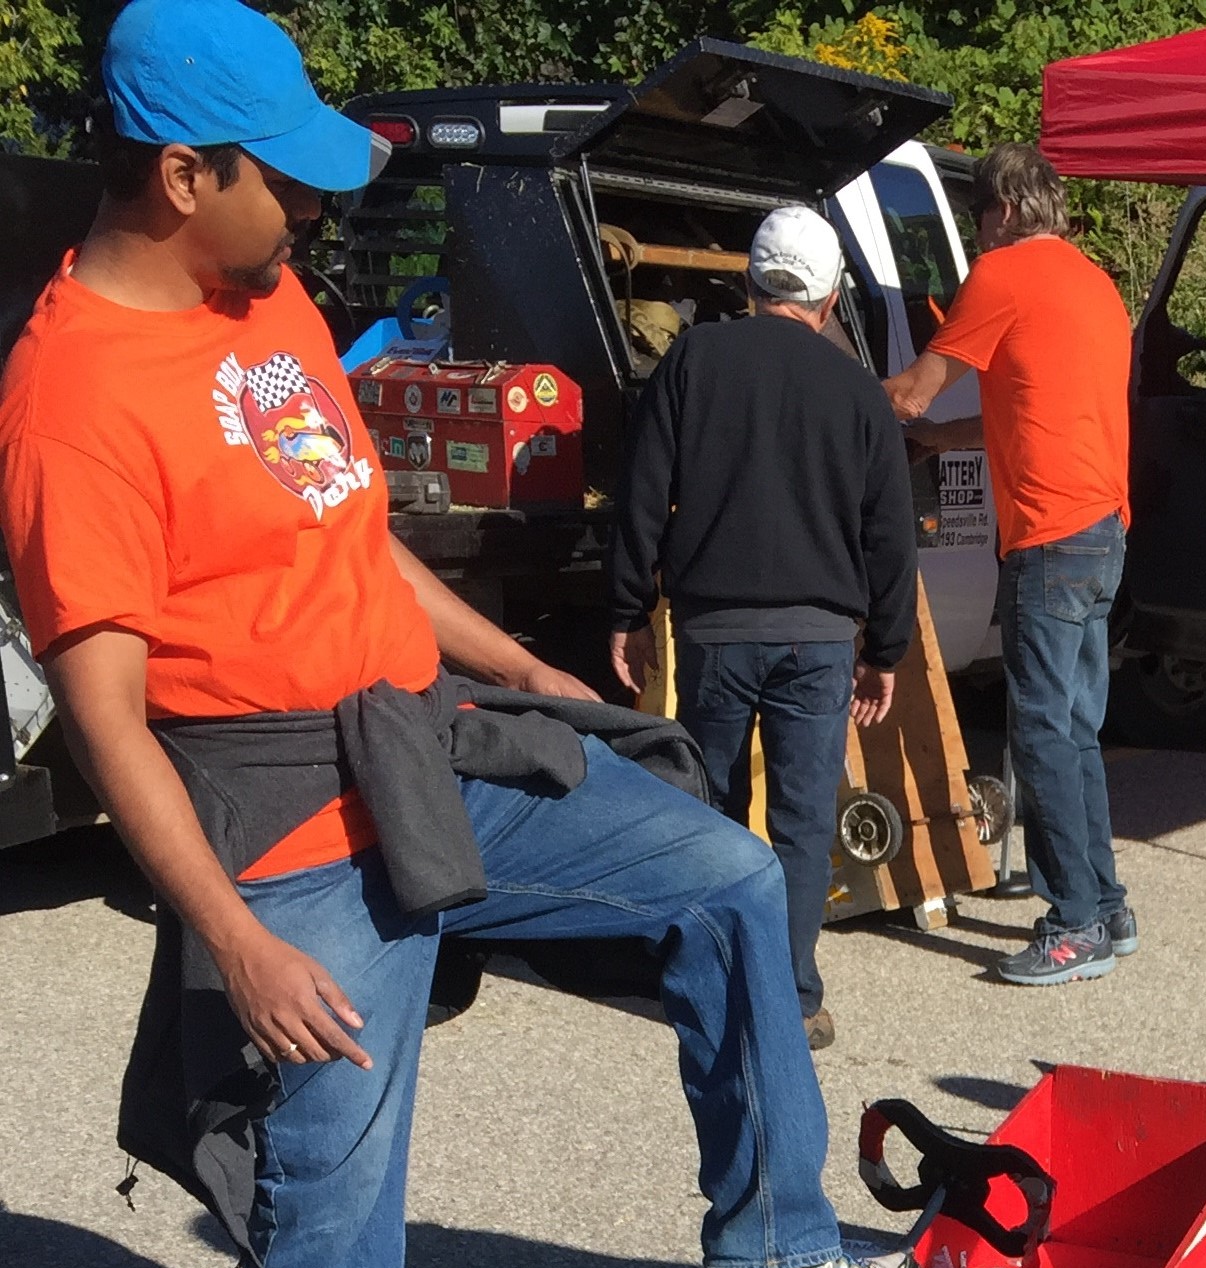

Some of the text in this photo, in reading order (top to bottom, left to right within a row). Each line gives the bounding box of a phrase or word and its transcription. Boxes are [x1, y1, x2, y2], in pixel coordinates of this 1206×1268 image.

[212, 352, 251, 446] SOAP BOX
[940, 490, 974, 505] SHOP
[940, 514, 977, 528] peedsville
